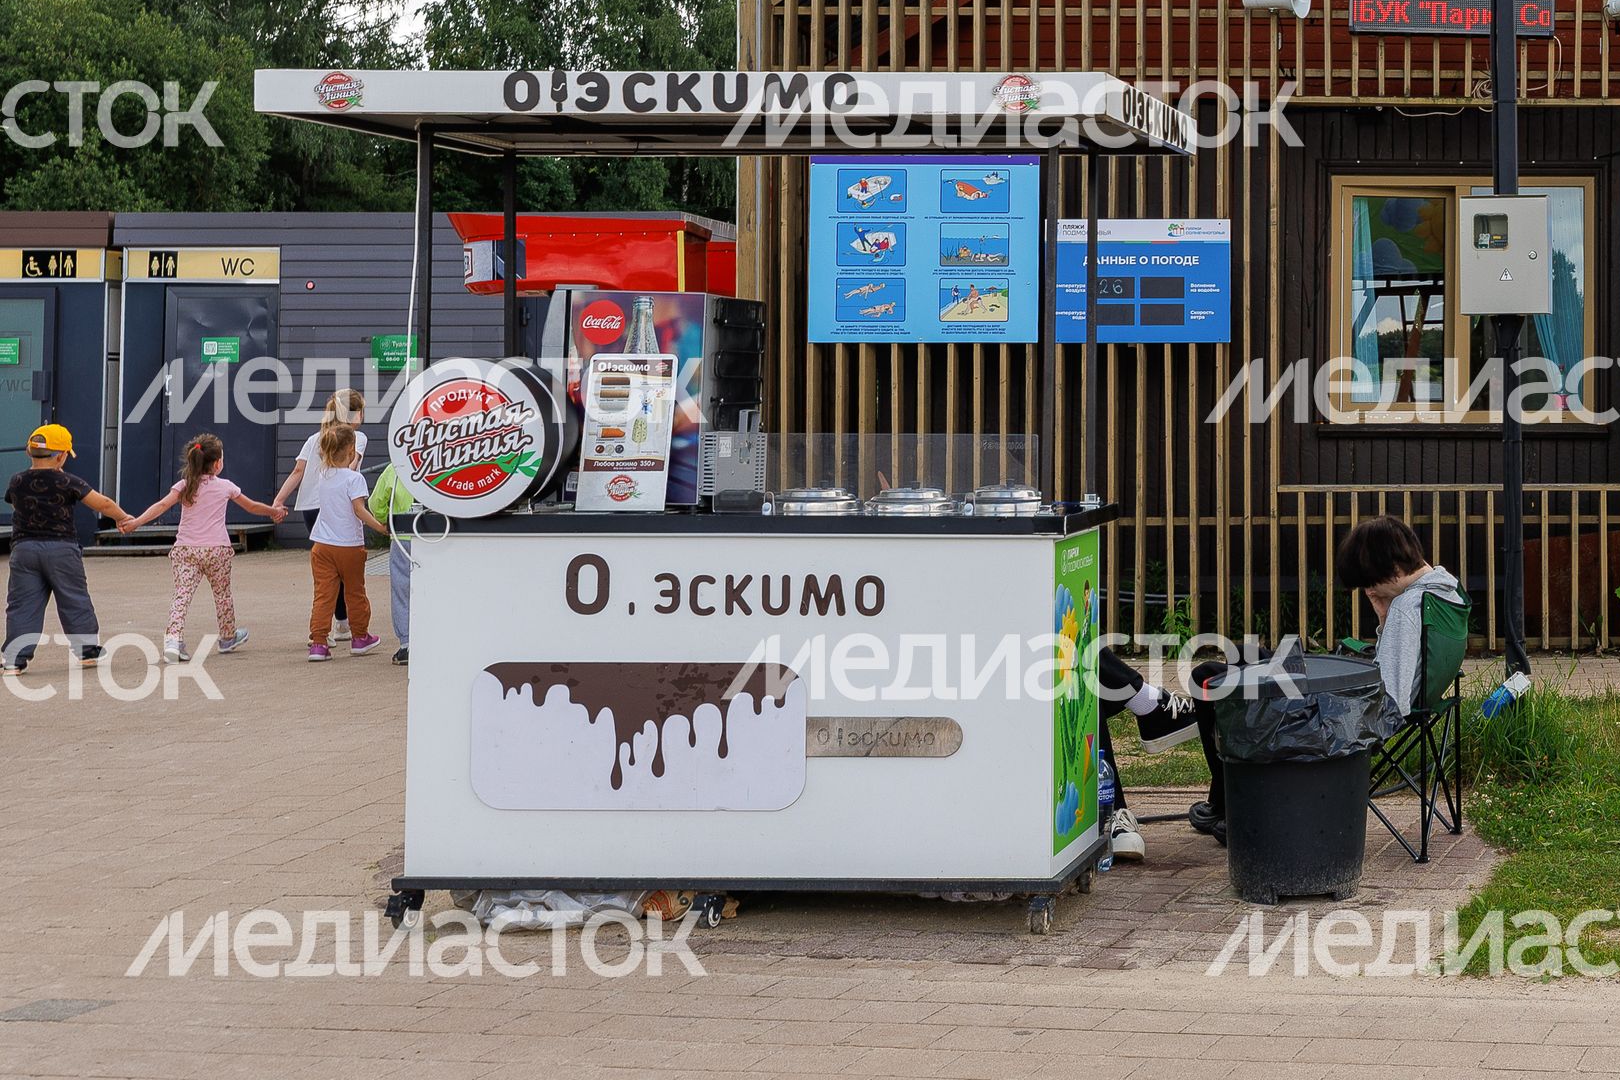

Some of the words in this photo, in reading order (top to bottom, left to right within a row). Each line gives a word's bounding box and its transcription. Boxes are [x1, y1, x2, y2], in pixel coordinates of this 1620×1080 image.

[1354, 0, 1410, 22] БУК
[221, 257, 255, 276] WC
[1139, 256, 1149, 265] О
[1151, 256, 1200, 266] ПОГОДЕ
[430, 389, 494, 412] ПРОДУКТ
[395, 402, 535, 450] Чистая
[412, 431, 533, 481] Линия
[446, 477, 475, 491] trade
[477, 469, 502, 487] mark
